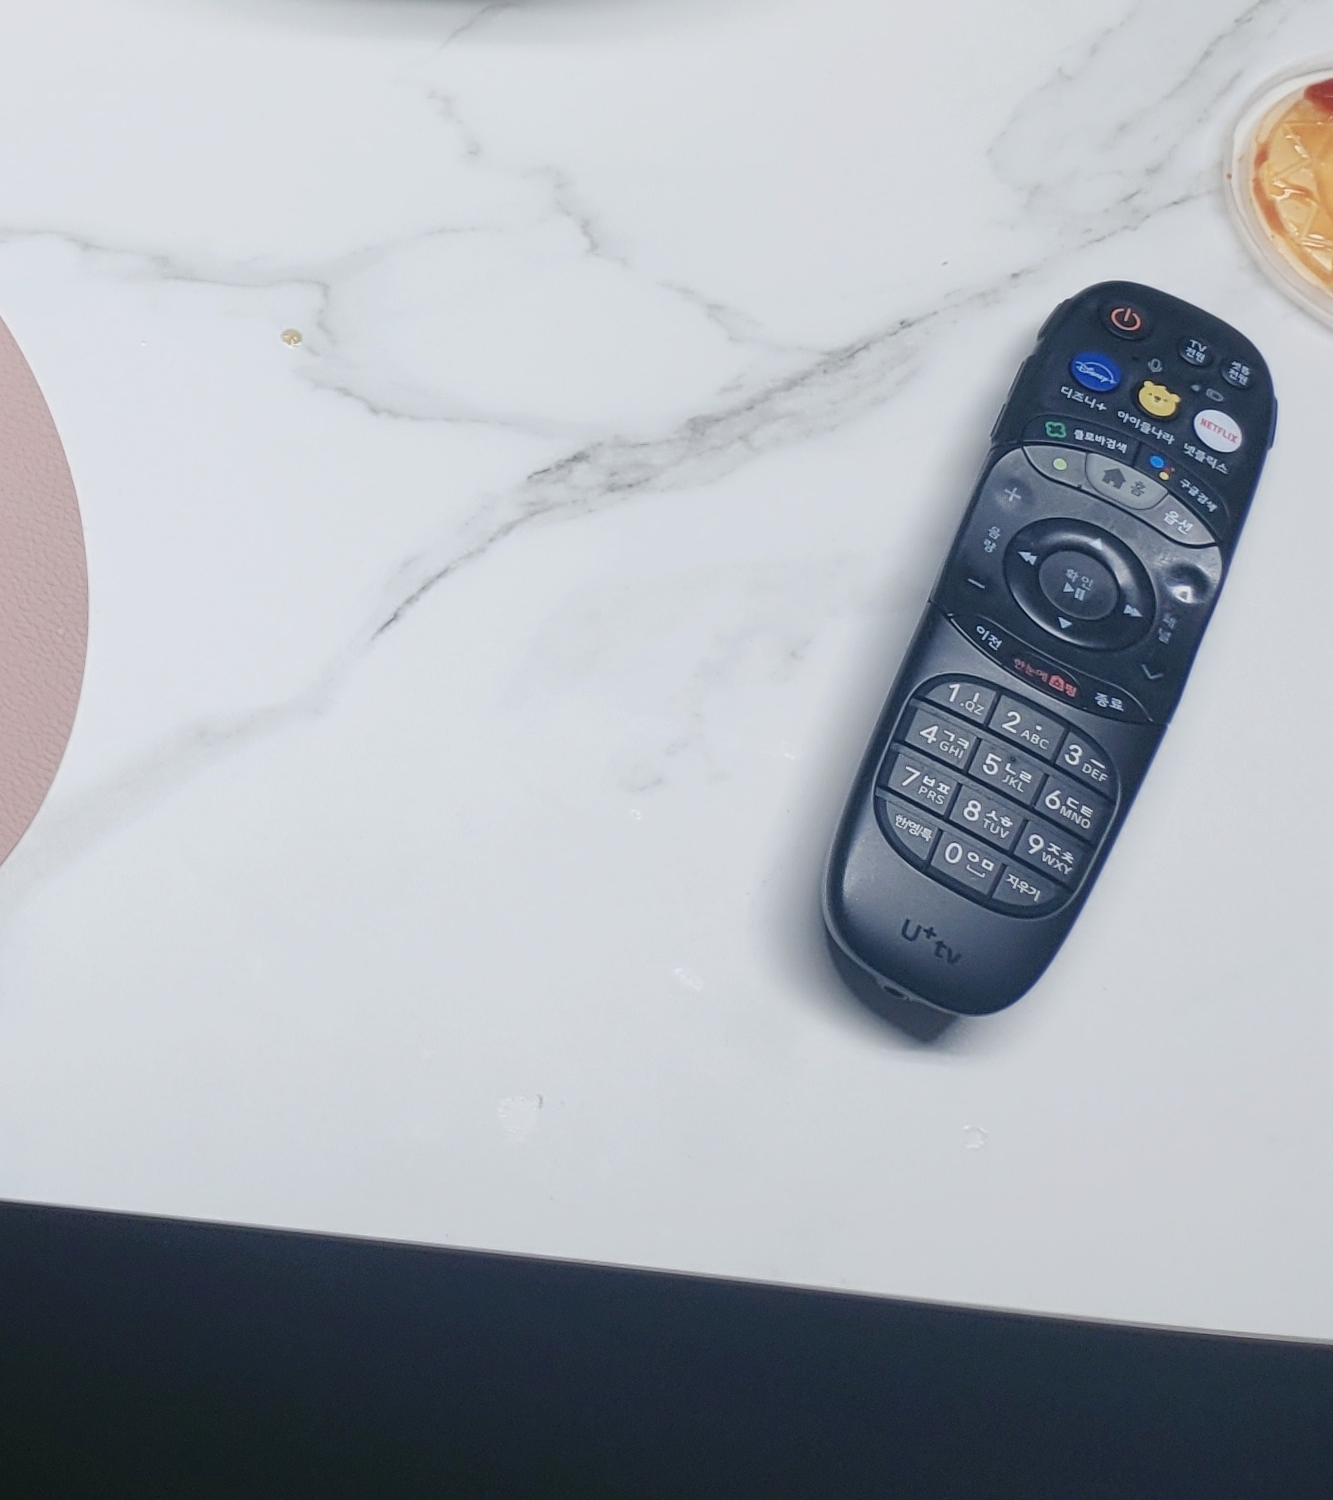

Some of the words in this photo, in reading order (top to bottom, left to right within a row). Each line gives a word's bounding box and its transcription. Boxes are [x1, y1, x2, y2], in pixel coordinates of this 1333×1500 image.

[1185, 347, 1206, 363] 전원
[1188, 339, 1208, 352] TV
[1060, 385, 1108, 412] 디즈니+
[1117, 409, 1176, 445] 아이들나라
[1199, 417, 1238, 444] NETFLIX
[1162, 509, 1194, 535] 옵션
[1066, 568, 1093, 591] 확인
[975, 624, 1003, 652] 이전
[949, 683, 961, 704] 1
[1001, 711, 1022, 735] 2
[919, 725, 938, 745] 4
[1020, 729, 1050, 751] ABC
[938, 740, 965, 760] GHI
[1064, 744, 1084, 767] 3
[982, 752, 1002, 776] 5
[1081, 763, 1109, 784] DEF
[901, 765, 921, 788] 7
[1001, 773, 1025, 794] JKL
[917, 786, 946, 806] PRS
[1044, 789, 1062, 812] 6
[963, 799, 983, 823] 8
[1059, 805, 1092, 831] MNO
[982, 818, 1011, 840] TUV
[944, 841, 964, 865] 0
[1028, 833, 1046, 856] 9
[1041, 851, 1075, 876] WXY
[1005, 873, 1042, 903] 지우기
